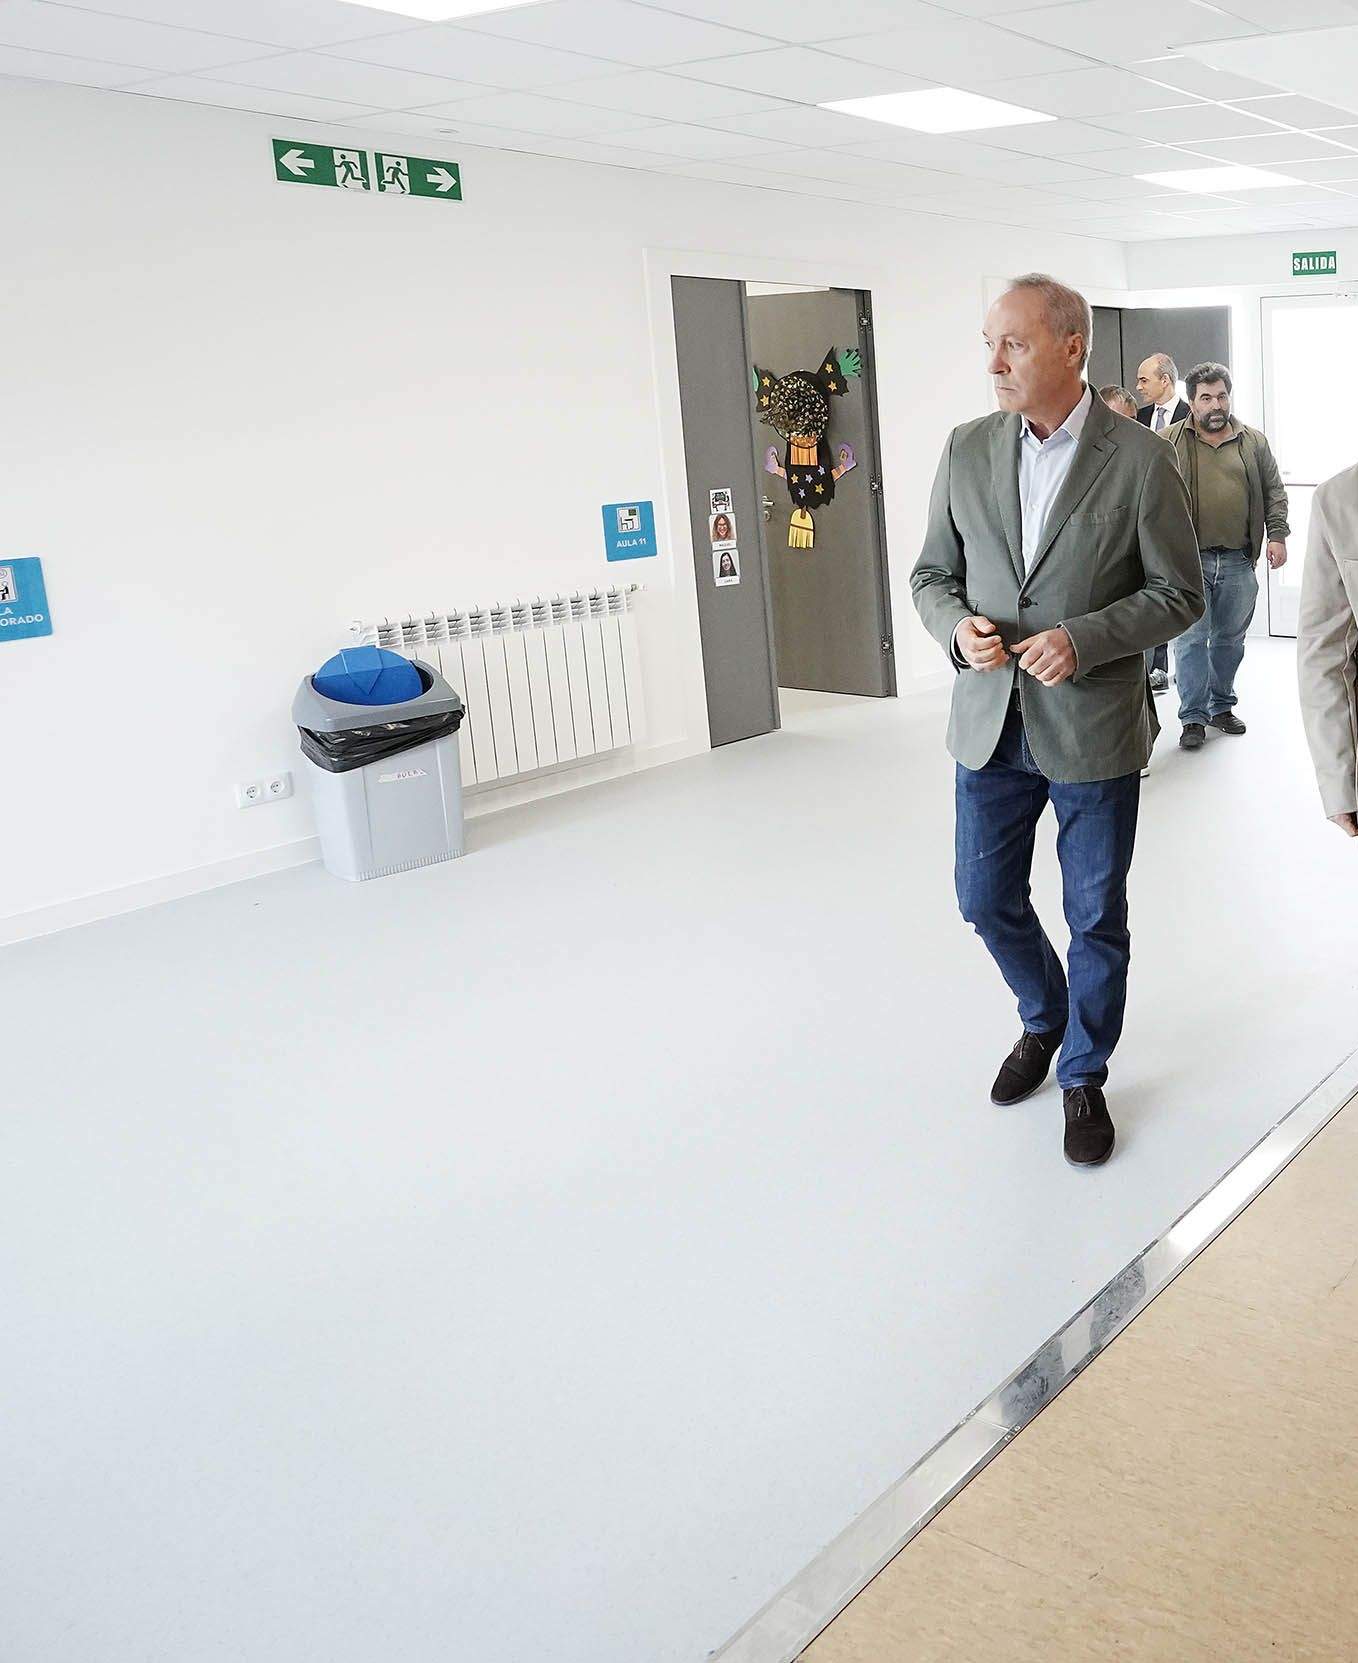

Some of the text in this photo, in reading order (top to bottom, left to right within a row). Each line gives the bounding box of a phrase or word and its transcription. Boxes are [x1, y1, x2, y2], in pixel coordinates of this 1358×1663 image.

[1293, 256, 1336, 271] SALIDA
[616, 537, 647, 548] AULA 11
[0, 613, 44, 627] ORADO
